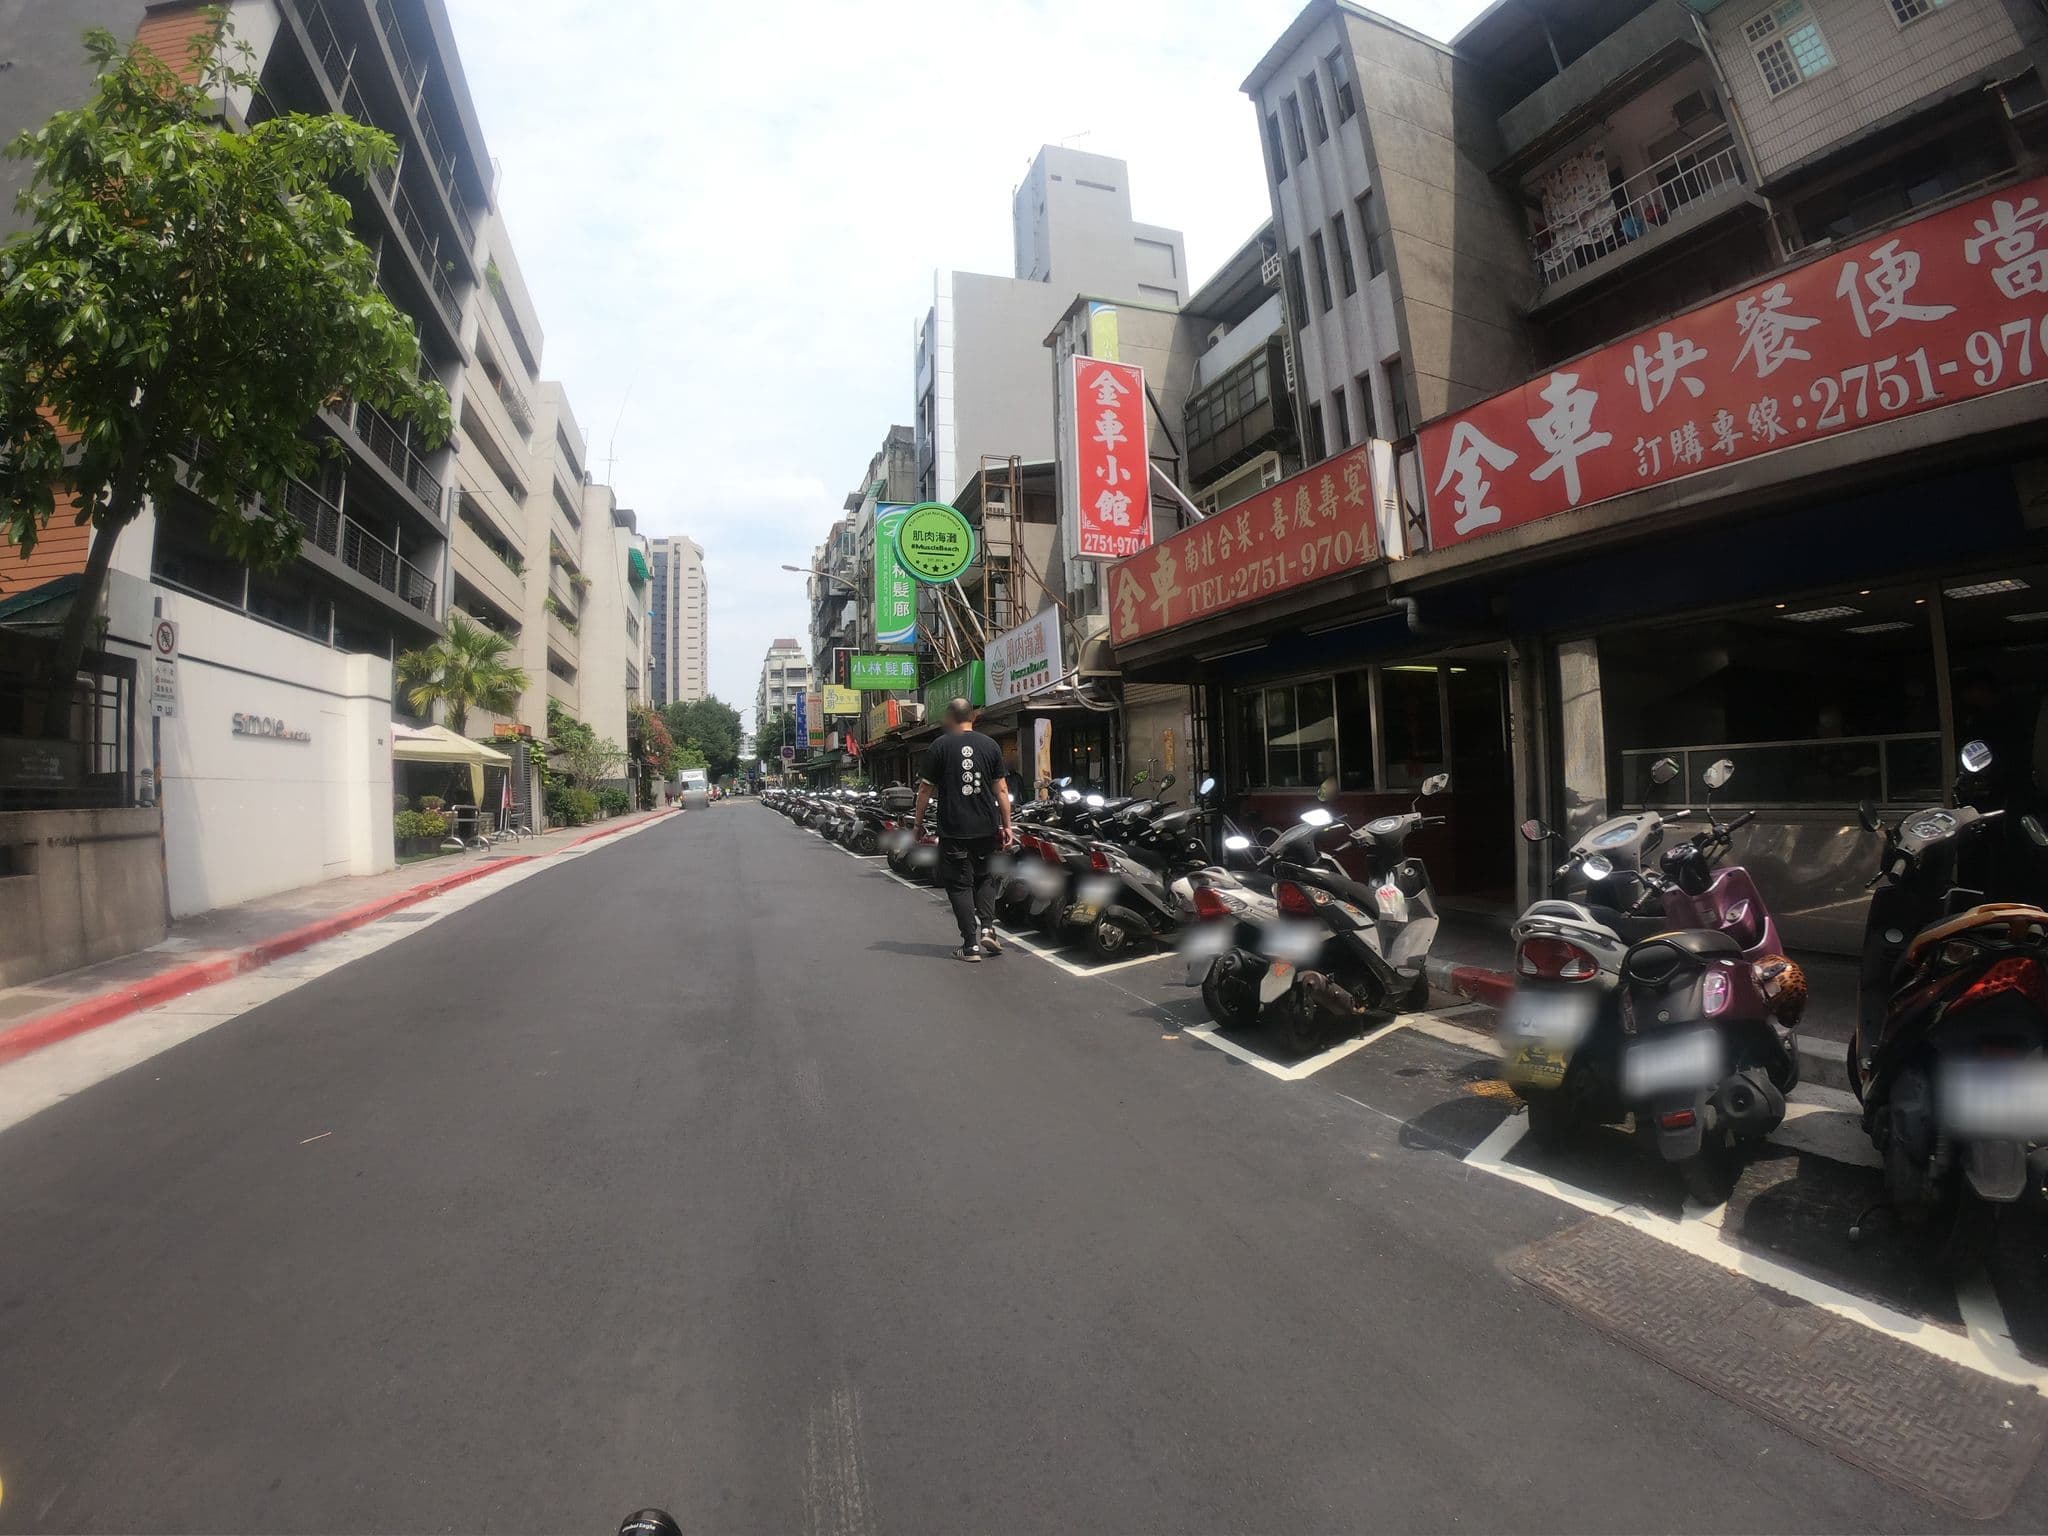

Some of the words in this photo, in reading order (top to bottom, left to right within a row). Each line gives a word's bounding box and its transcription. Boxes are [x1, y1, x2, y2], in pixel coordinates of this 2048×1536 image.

[1633, 314, 2048, 479] 訂購專線:2751-97
[1088, 369, 1132, 527] 金車小館
[913, 530, 957, 543] 肌肉海灘
[1084, 532, 1146, 555] 2751-9704
[1186, 522, 1370, 614] TEL:2751-9704
[1112, 544, 1181, 639] 金車
[852, 660, 915, 676] 小林髮廊
